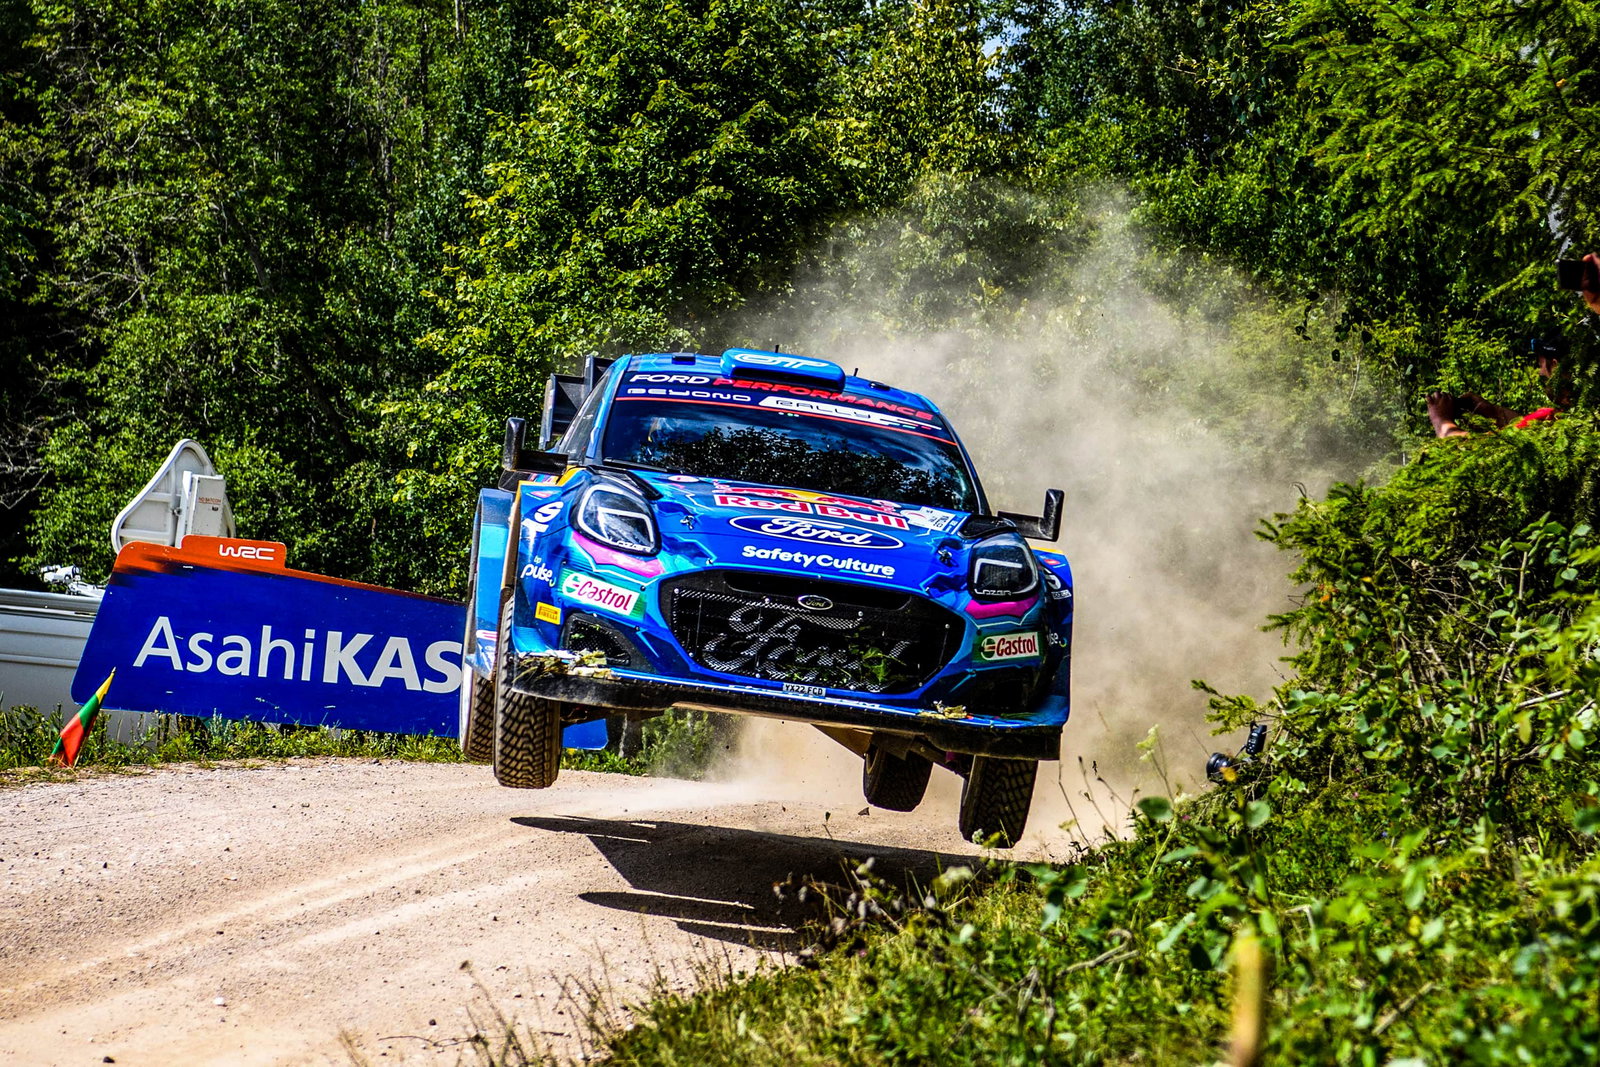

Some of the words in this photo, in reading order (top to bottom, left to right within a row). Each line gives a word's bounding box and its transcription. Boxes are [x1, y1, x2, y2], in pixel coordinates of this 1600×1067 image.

[627, 388, 751, 402] BEYOND
[629, 374, 710, 385] FORD
[712, 377, 934, 420] PERFORMANCE
[715, 494, 811, 513] Red
[816, 503, 910, 530] Bull
[760, 517, 873, 546] Ford
[219, 544, 275, 561] WRC
[742, 545, 896, 577] SafetyCulture
[520, 563, 553, 582] pulse
[577, 580, 633, 611] Castrol
[996, 635, 1037, 657] Castrol
